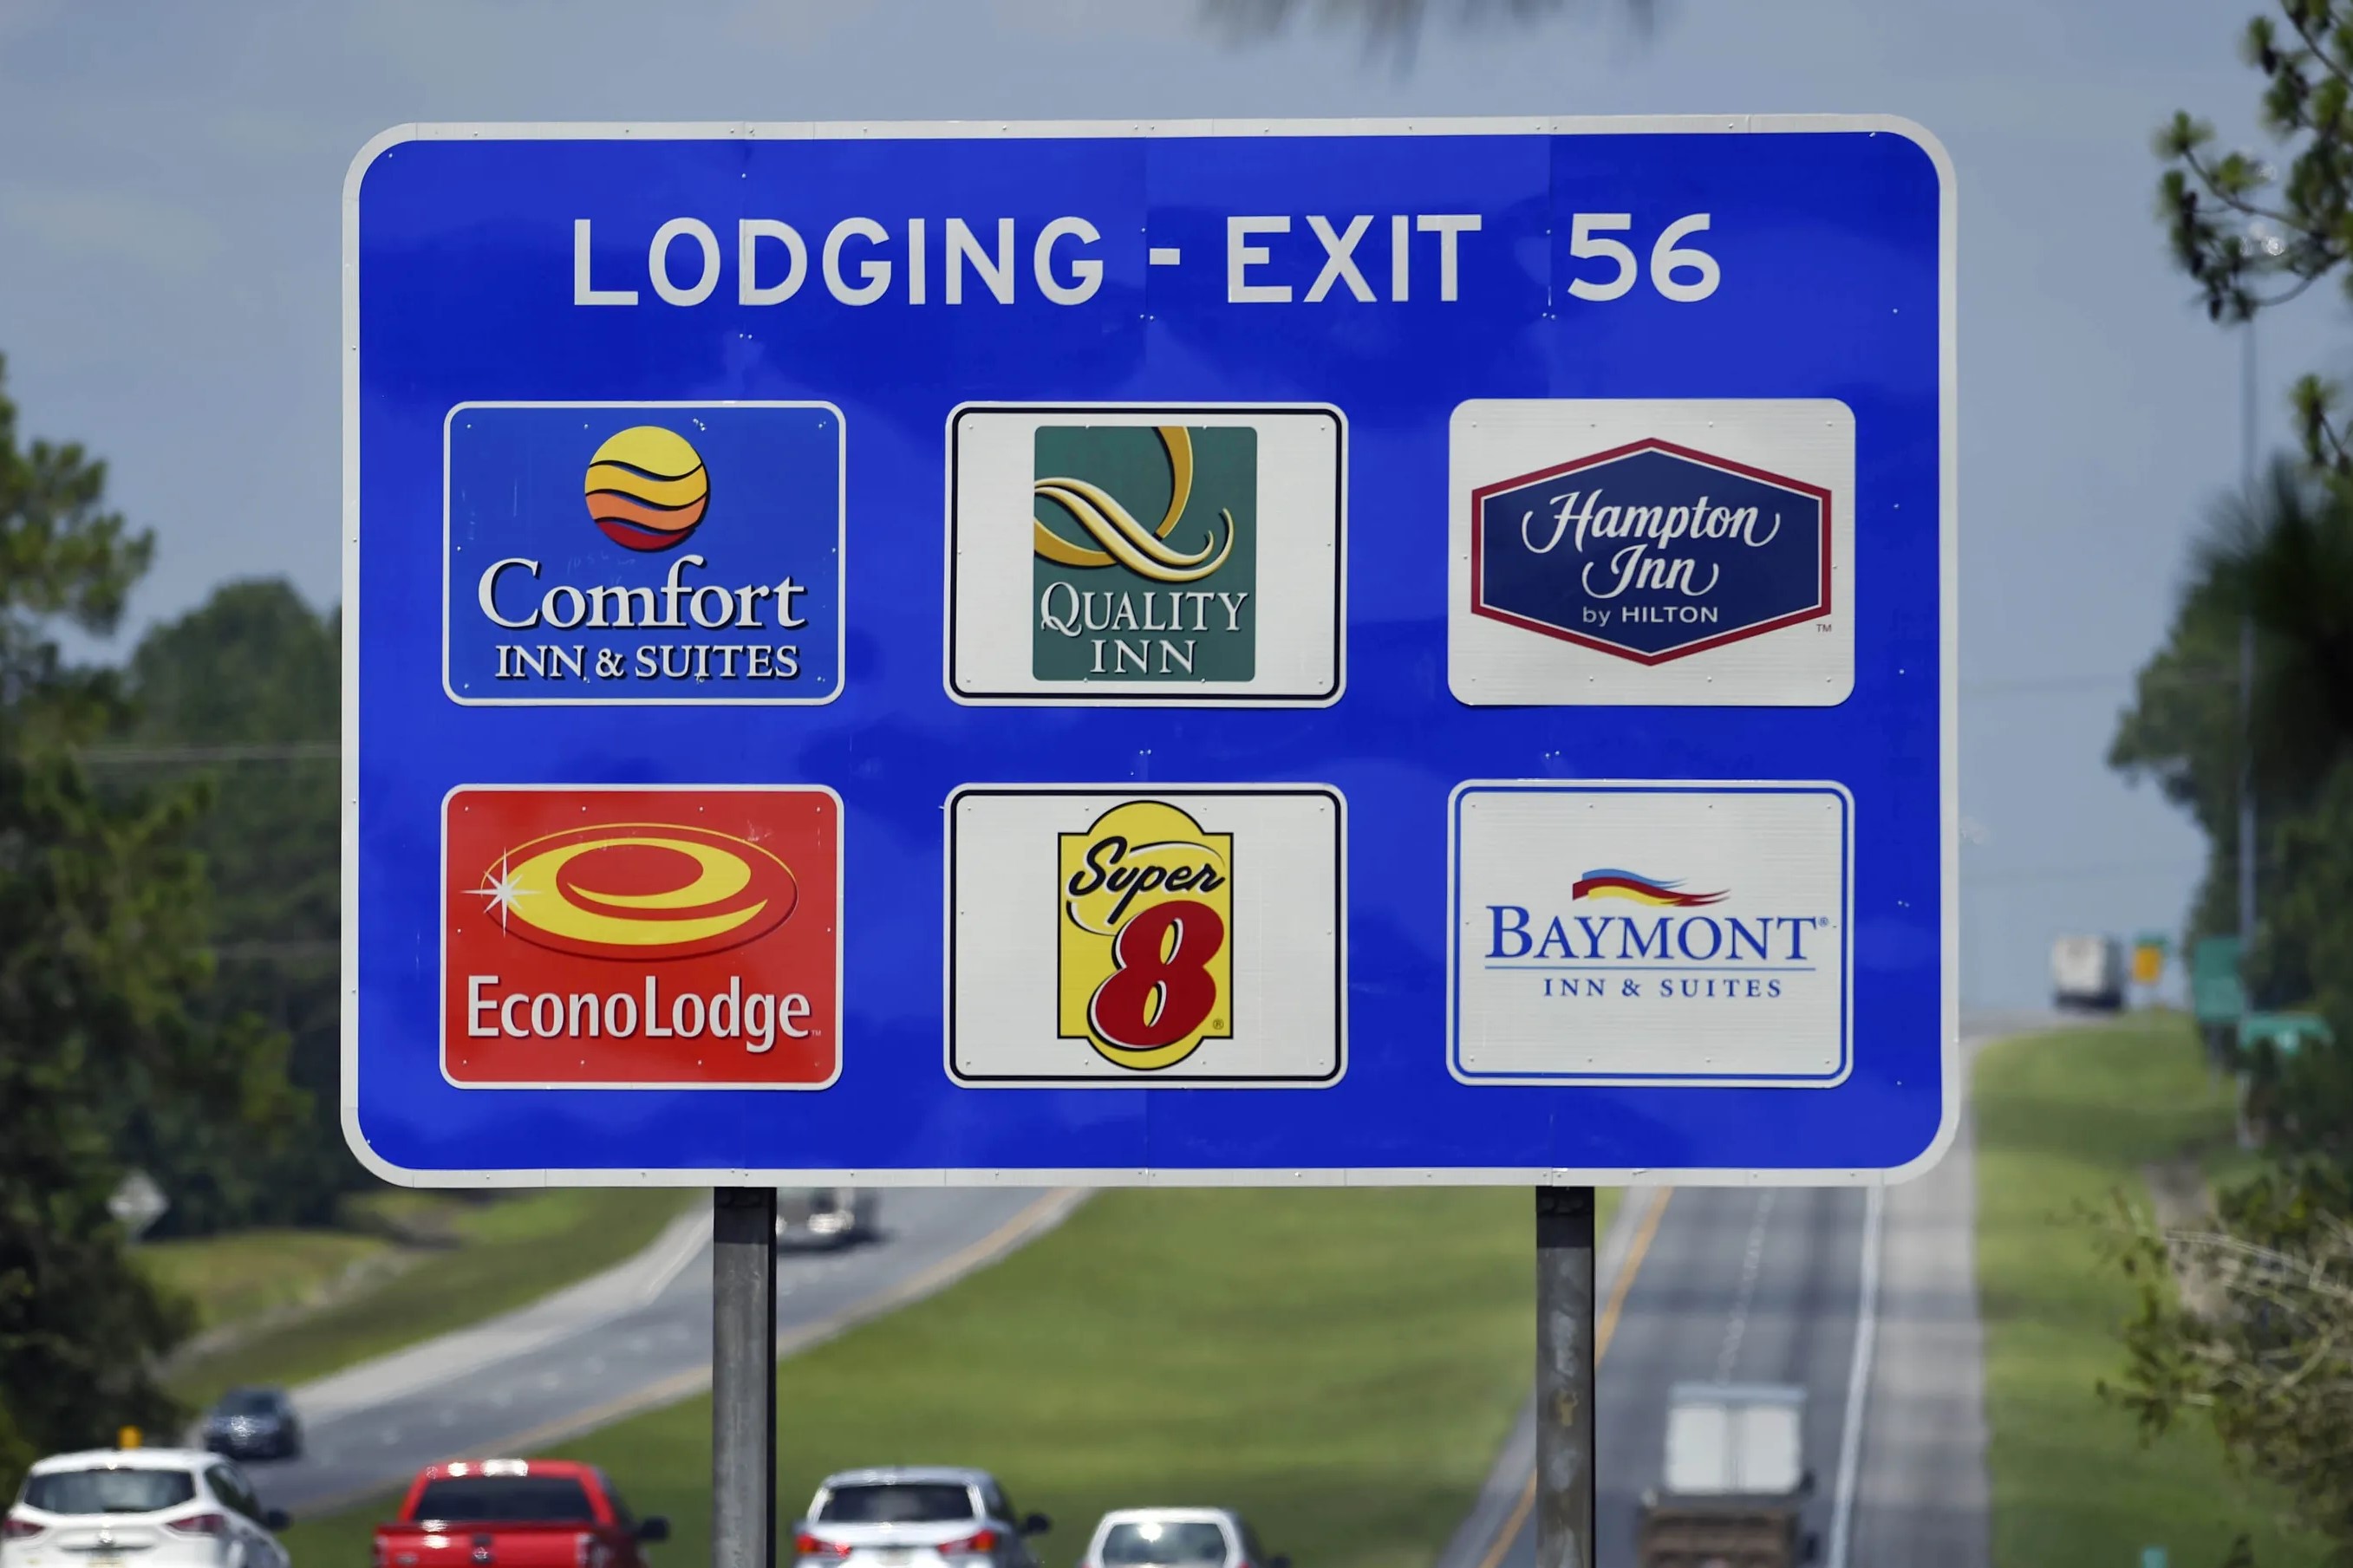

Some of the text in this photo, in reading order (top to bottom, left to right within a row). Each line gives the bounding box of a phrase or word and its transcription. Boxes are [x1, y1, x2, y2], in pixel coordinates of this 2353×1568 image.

[574, 212, 1721, 307] LODGING - EXIT 56
[1521, 489, 1781, 554] Hampton
[478, 554, 806, 629] Comfort
[1581, 543, 1719, 599] Inn
[1040, 581, 1248, 637] QUALITY
[1582, 606, 1719, 627] by HILTON
[494, 644, 799, 680] INN & SUITES
[1090, 639, 1197, 674] INN
[1068, 835, 1226, 926] Super
[1086, 899, 1225, 1052] 8
[1543, 978, 1782, 998] INN & SUITES
[467, 975, 811, 1053] EconoLodge
